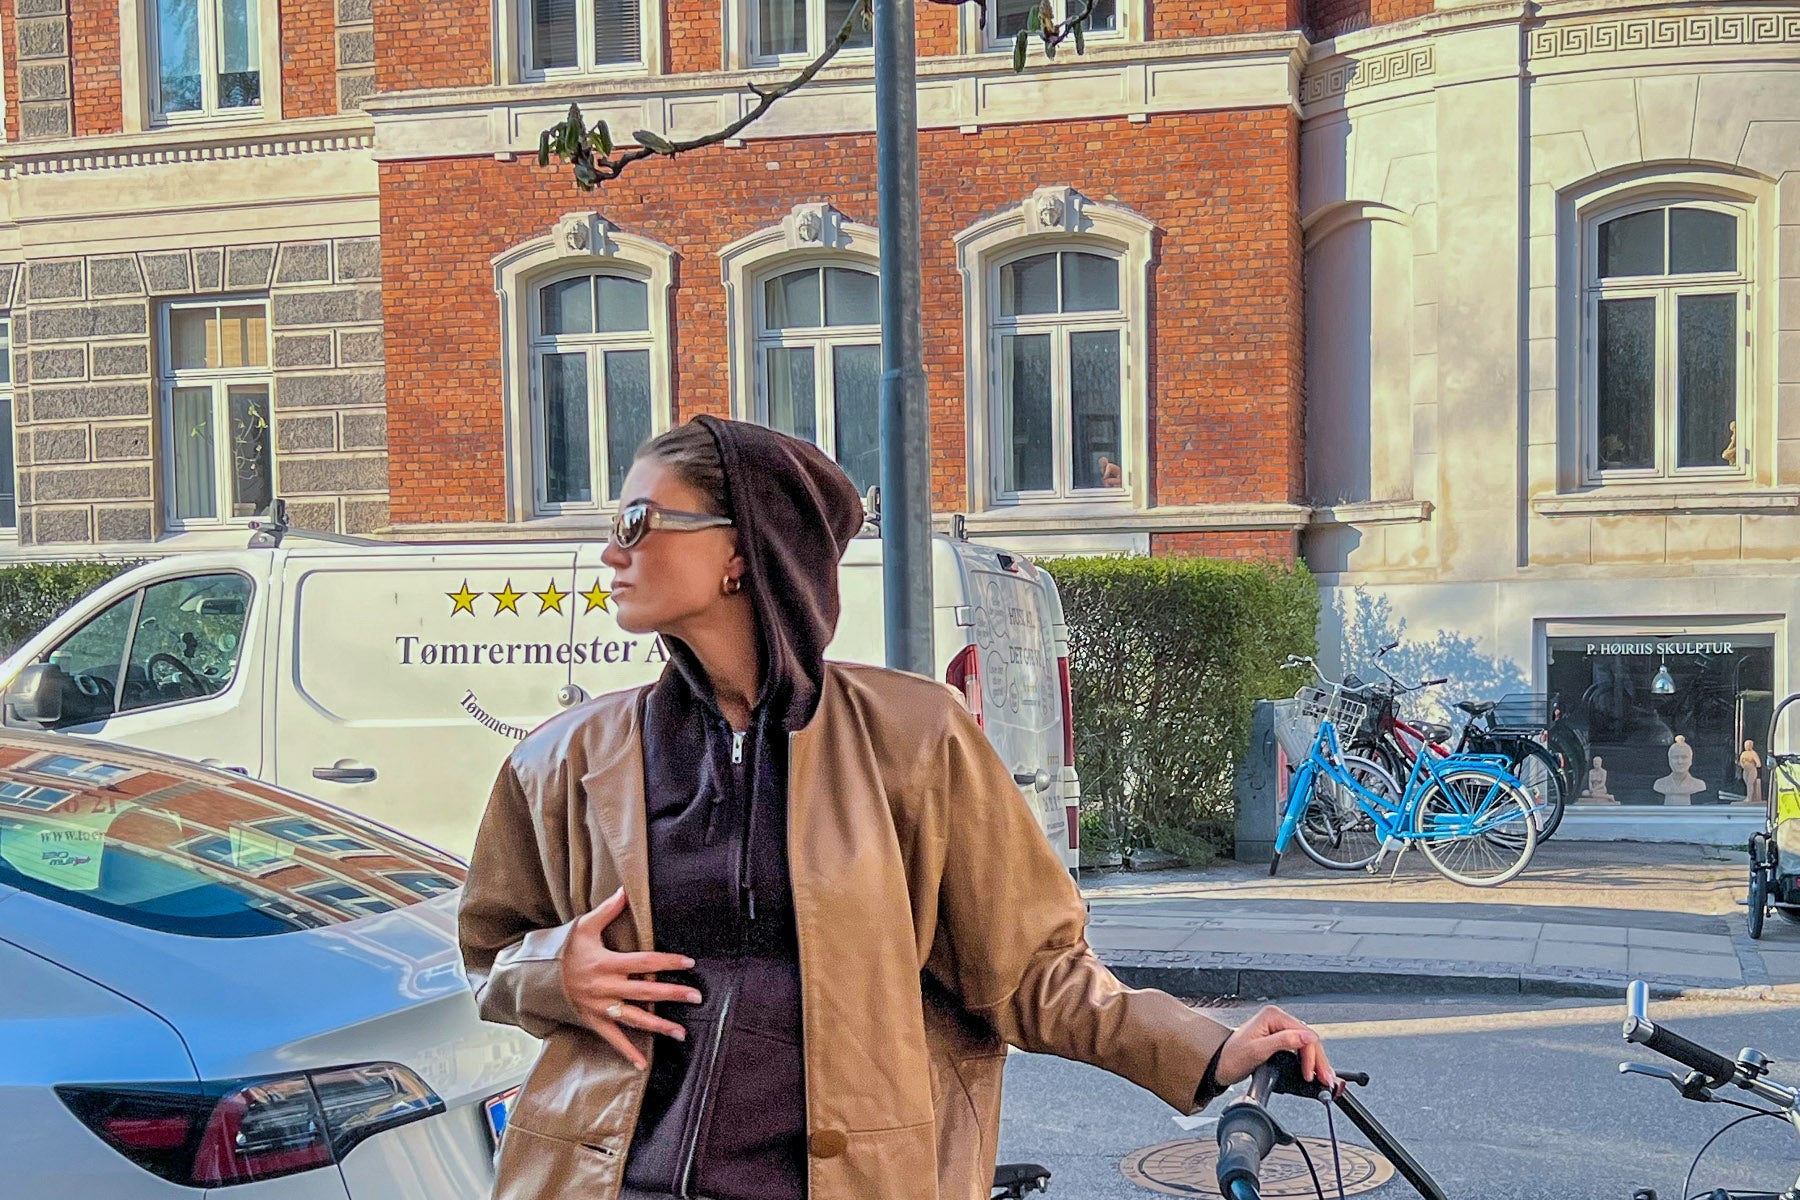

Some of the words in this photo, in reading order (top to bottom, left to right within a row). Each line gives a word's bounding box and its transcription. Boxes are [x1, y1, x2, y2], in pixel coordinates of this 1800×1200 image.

[395, 636, 638, 665] Tømrermester
[1586, 643, 1598, 656] P.
[1600, 642, 1654, 656] HØIRIIS
[1656, 641, 1734, 655] SKULPTUR
